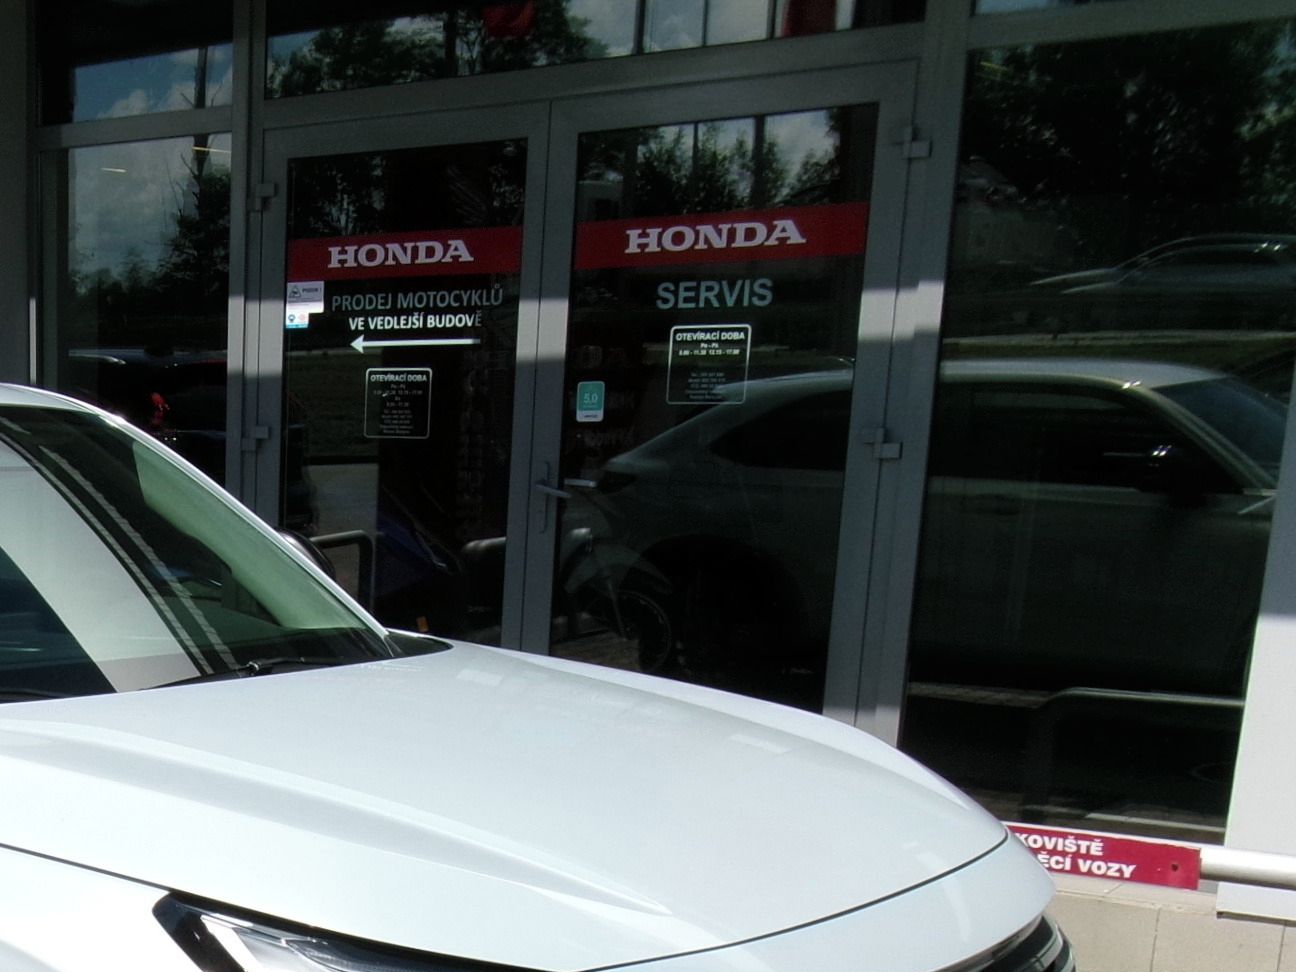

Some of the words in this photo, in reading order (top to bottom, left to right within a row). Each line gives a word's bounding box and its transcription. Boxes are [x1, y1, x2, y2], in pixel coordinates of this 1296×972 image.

[624, 219, 806, 254] HONDA
[327, 239, 474, 268] HONDA
[332, 292, 392, 312] PRODEJ
[397, 284, 503, 310] MOTOCYKLŮ
[656, 278, 773, 310] SERVIS
[349, 316, 365, 331] VE
[368, 312, 424, 330] VEDLEJŠÍ
[427, 310, 482, 329] BUDOVĚ
[675, 331, 719, 341] OTEVÍRACÍ
[721, 332, 745, 340] DOBA
[370, 373, 407, 382] OTEVÍRACÍ
[407, 374, 427, 382] DOBA
[1077, 858, 1137, 879] VOZY
